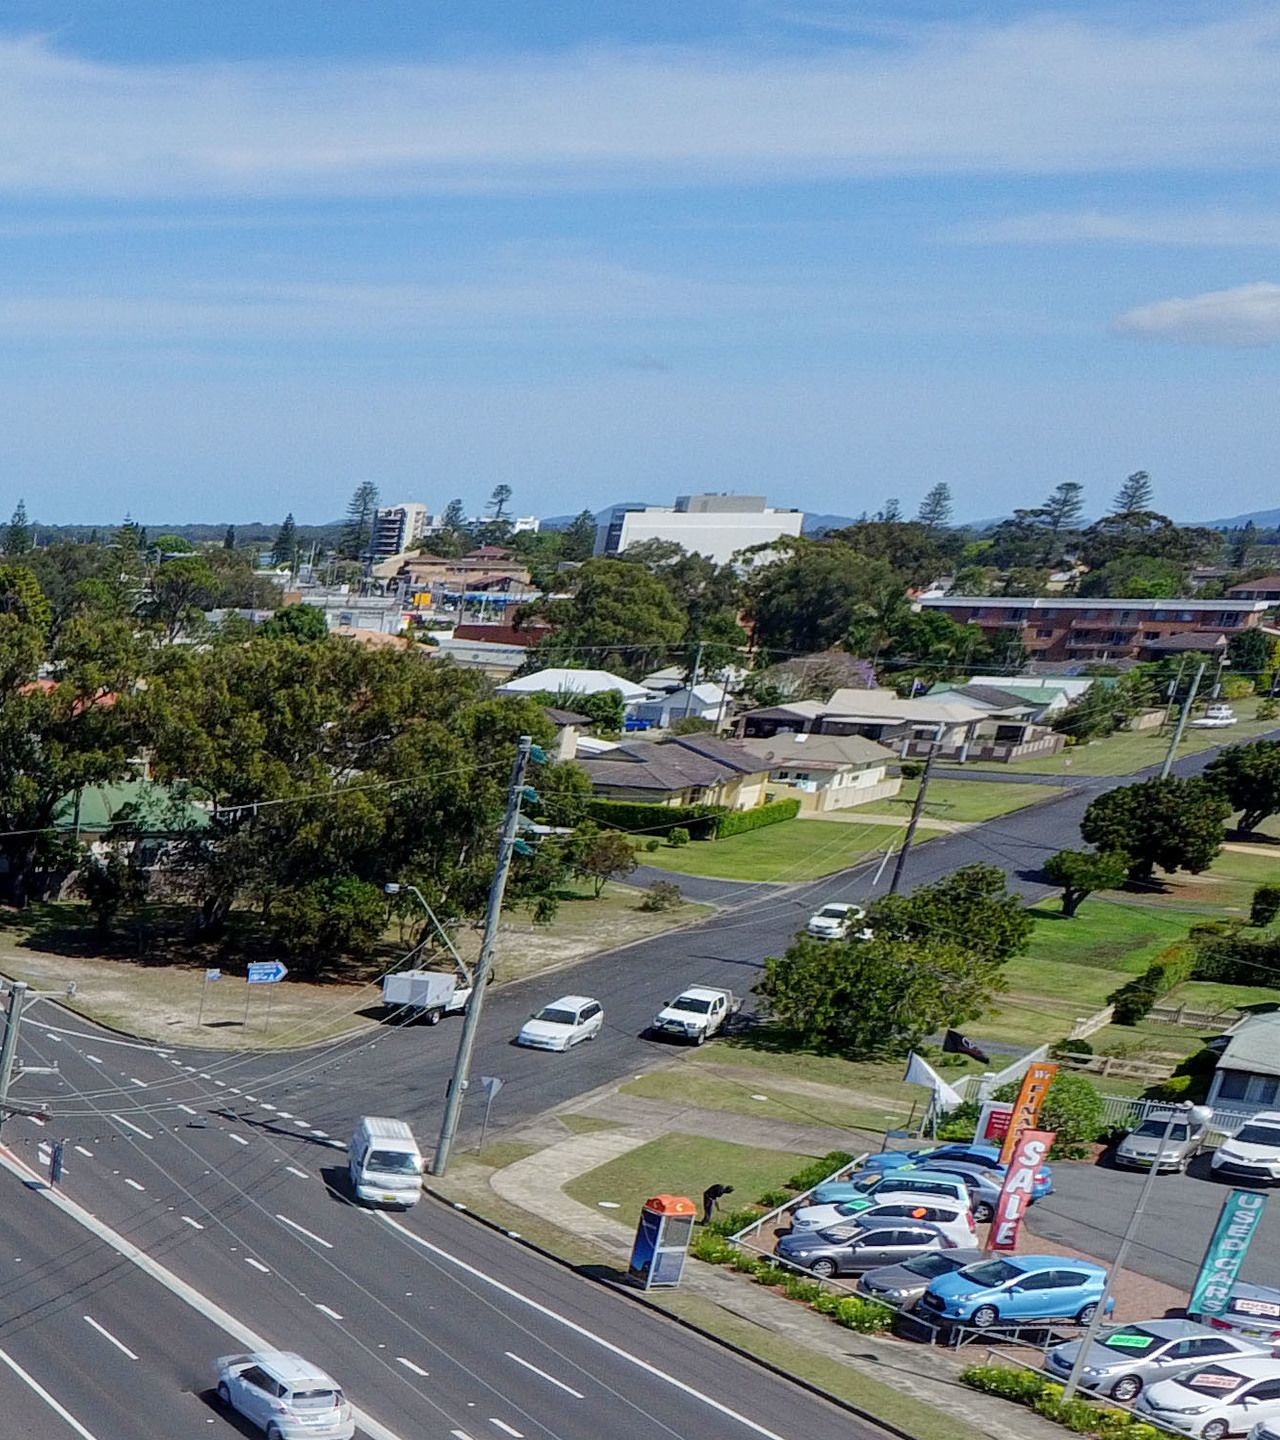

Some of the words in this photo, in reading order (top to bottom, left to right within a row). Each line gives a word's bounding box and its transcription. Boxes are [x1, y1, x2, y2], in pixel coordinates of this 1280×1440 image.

[996, 1141, 1045, 1245] SALE
[1221, 1195, 1262, 1251] USED
[1201, 1257, 1238, 1313] CARS
